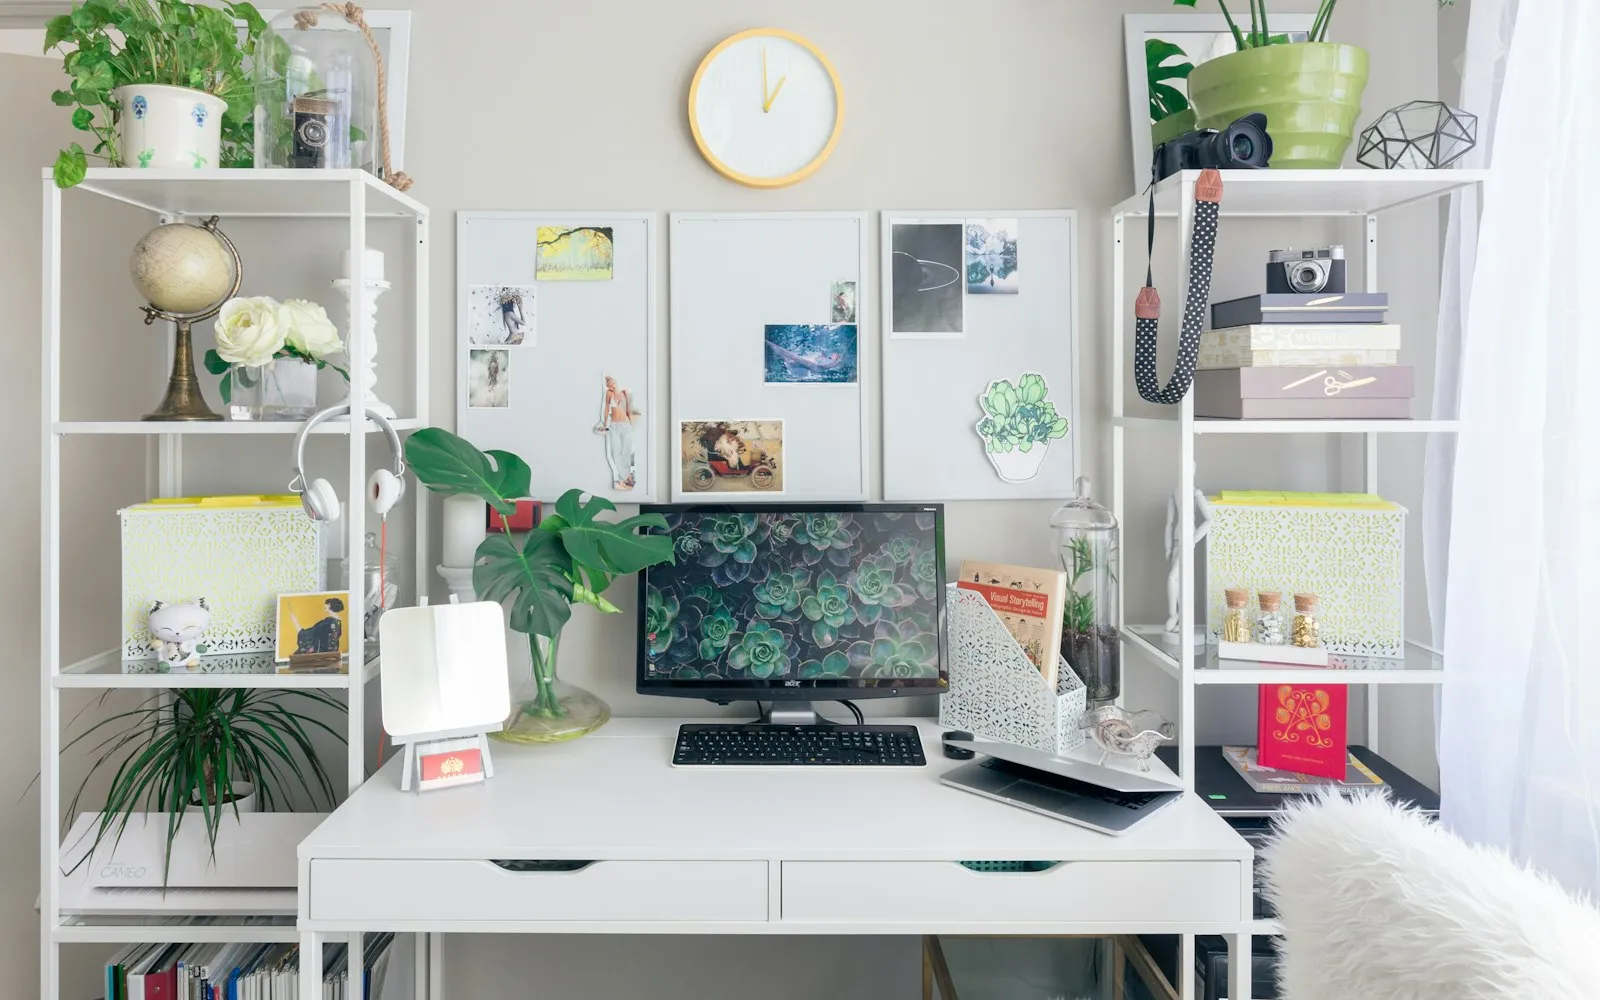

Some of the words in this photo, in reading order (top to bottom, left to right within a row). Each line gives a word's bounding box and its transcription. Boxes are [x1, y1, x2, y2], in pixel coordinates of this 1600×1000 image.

[990, 591, 1008, 603] Visual
[1009, 594, 1045, 611] Storytelling
[100, 866, 146, 879] CAMEO
